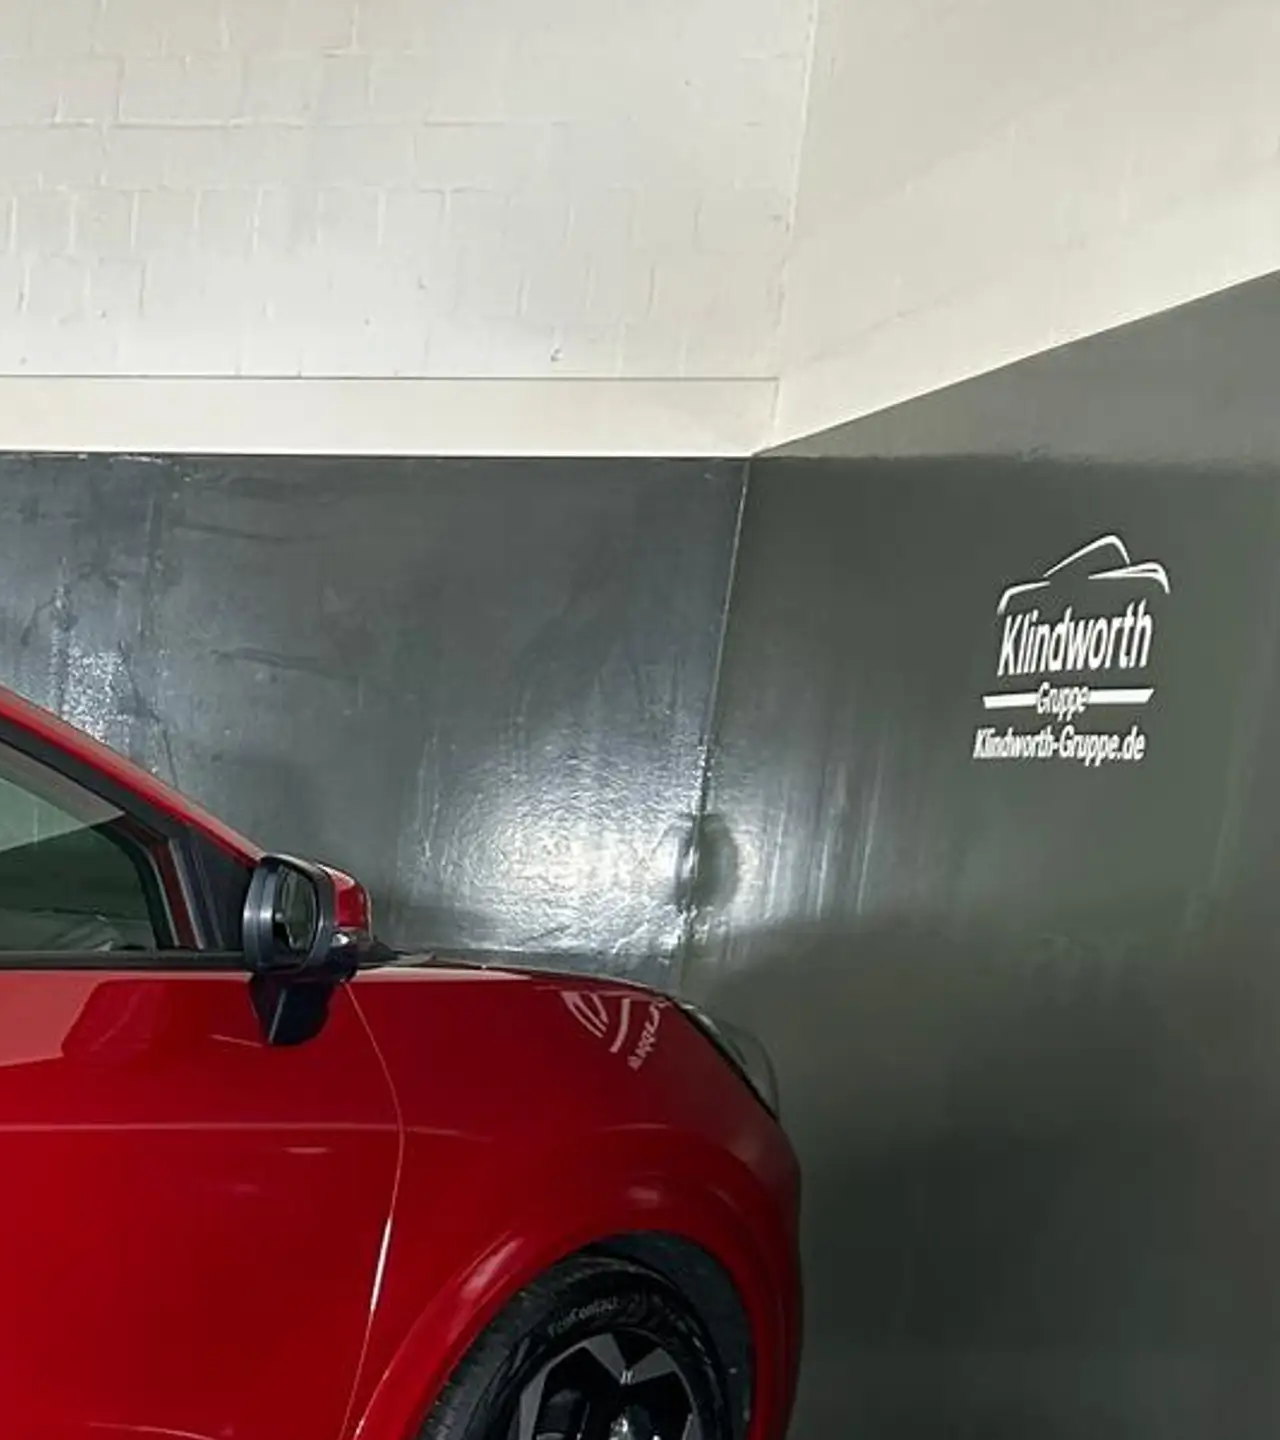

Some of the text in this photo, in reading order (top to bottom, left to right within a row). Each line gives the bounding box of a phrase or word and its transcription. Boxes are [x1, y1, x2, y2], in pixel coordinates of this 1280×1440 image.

[997, 599, 1153, 676] Klindworth
[1036, 682, 1090, 721] Gruppe
[973, 725, 1146, 767] Klindworth-Gruppe.de
